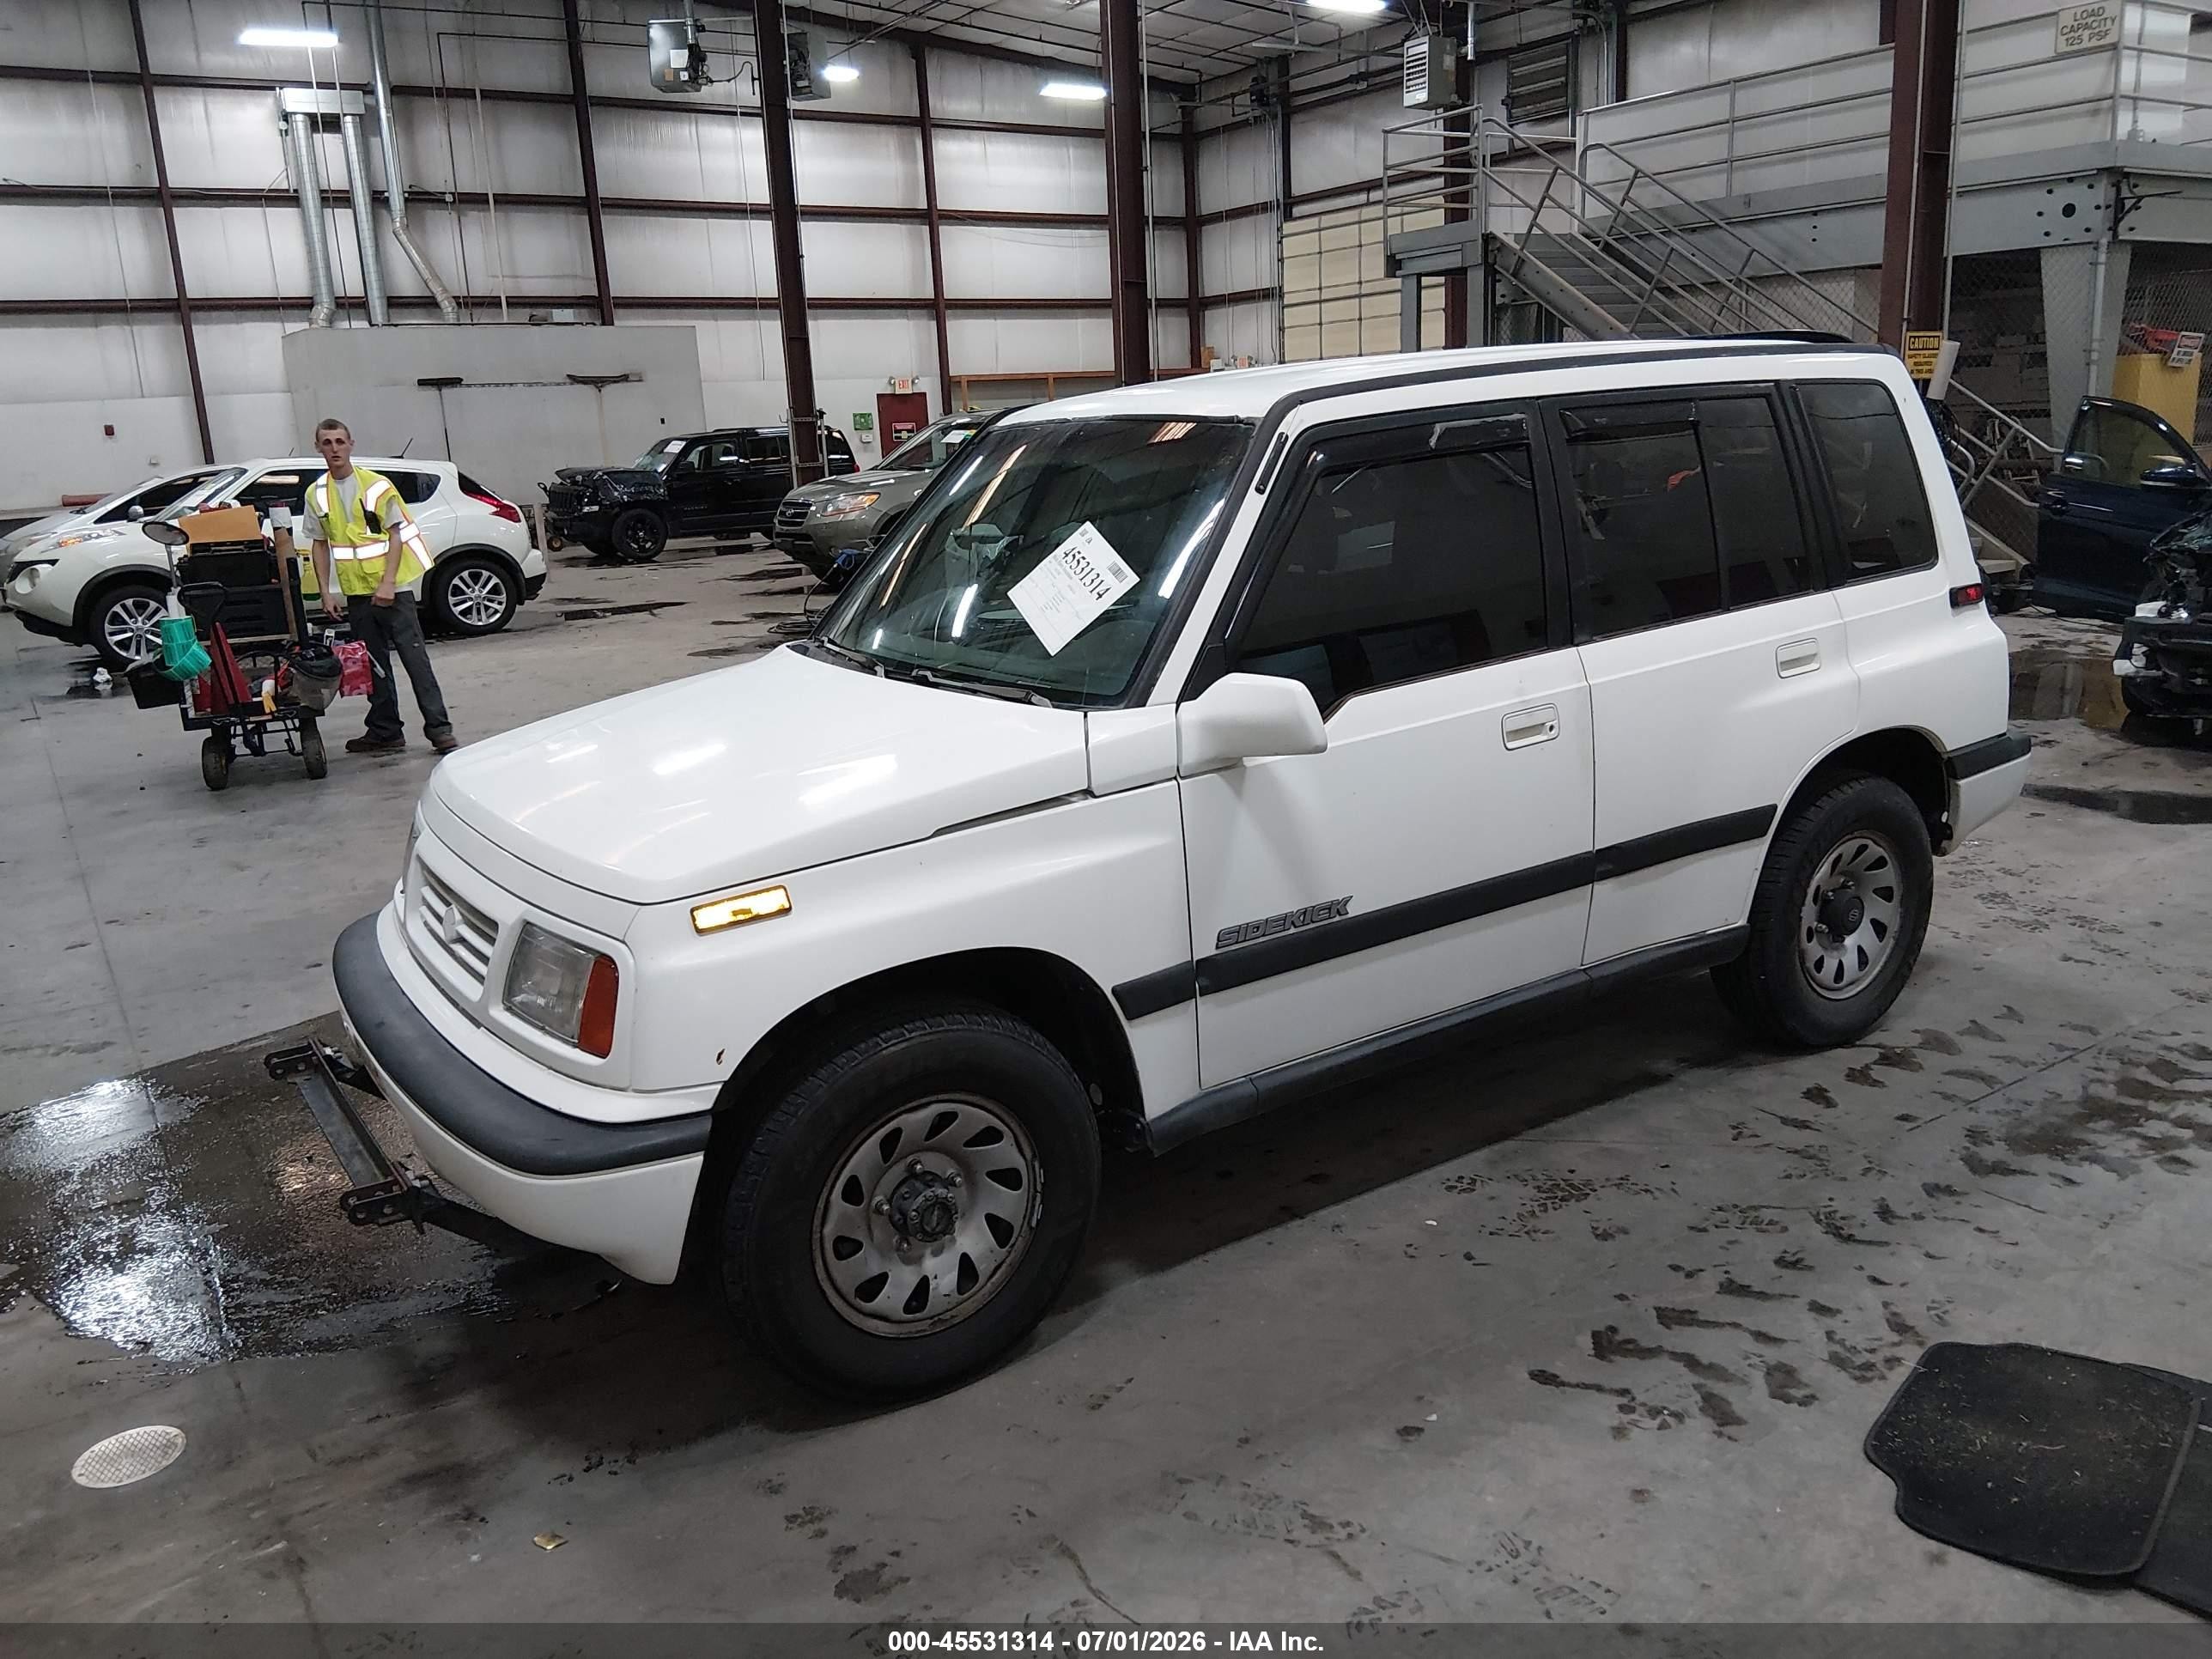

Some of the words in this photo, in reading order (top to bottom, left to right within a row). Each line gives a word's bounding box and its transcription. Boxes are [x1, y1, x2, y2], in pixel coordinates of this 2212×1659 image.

[2073, 6, 2106, 22] LOAD
[2060, 15, 2118, 36] CAPACITY
[2064, 34, 2083, 47] 125
[2087, 28, 2112, 43] PSF
[1909, 337, 1940, 349] CAUTION
[1061, 545, 1113, 601] 45531314
[1215, 895, 1354, 951] SIDEKICK
